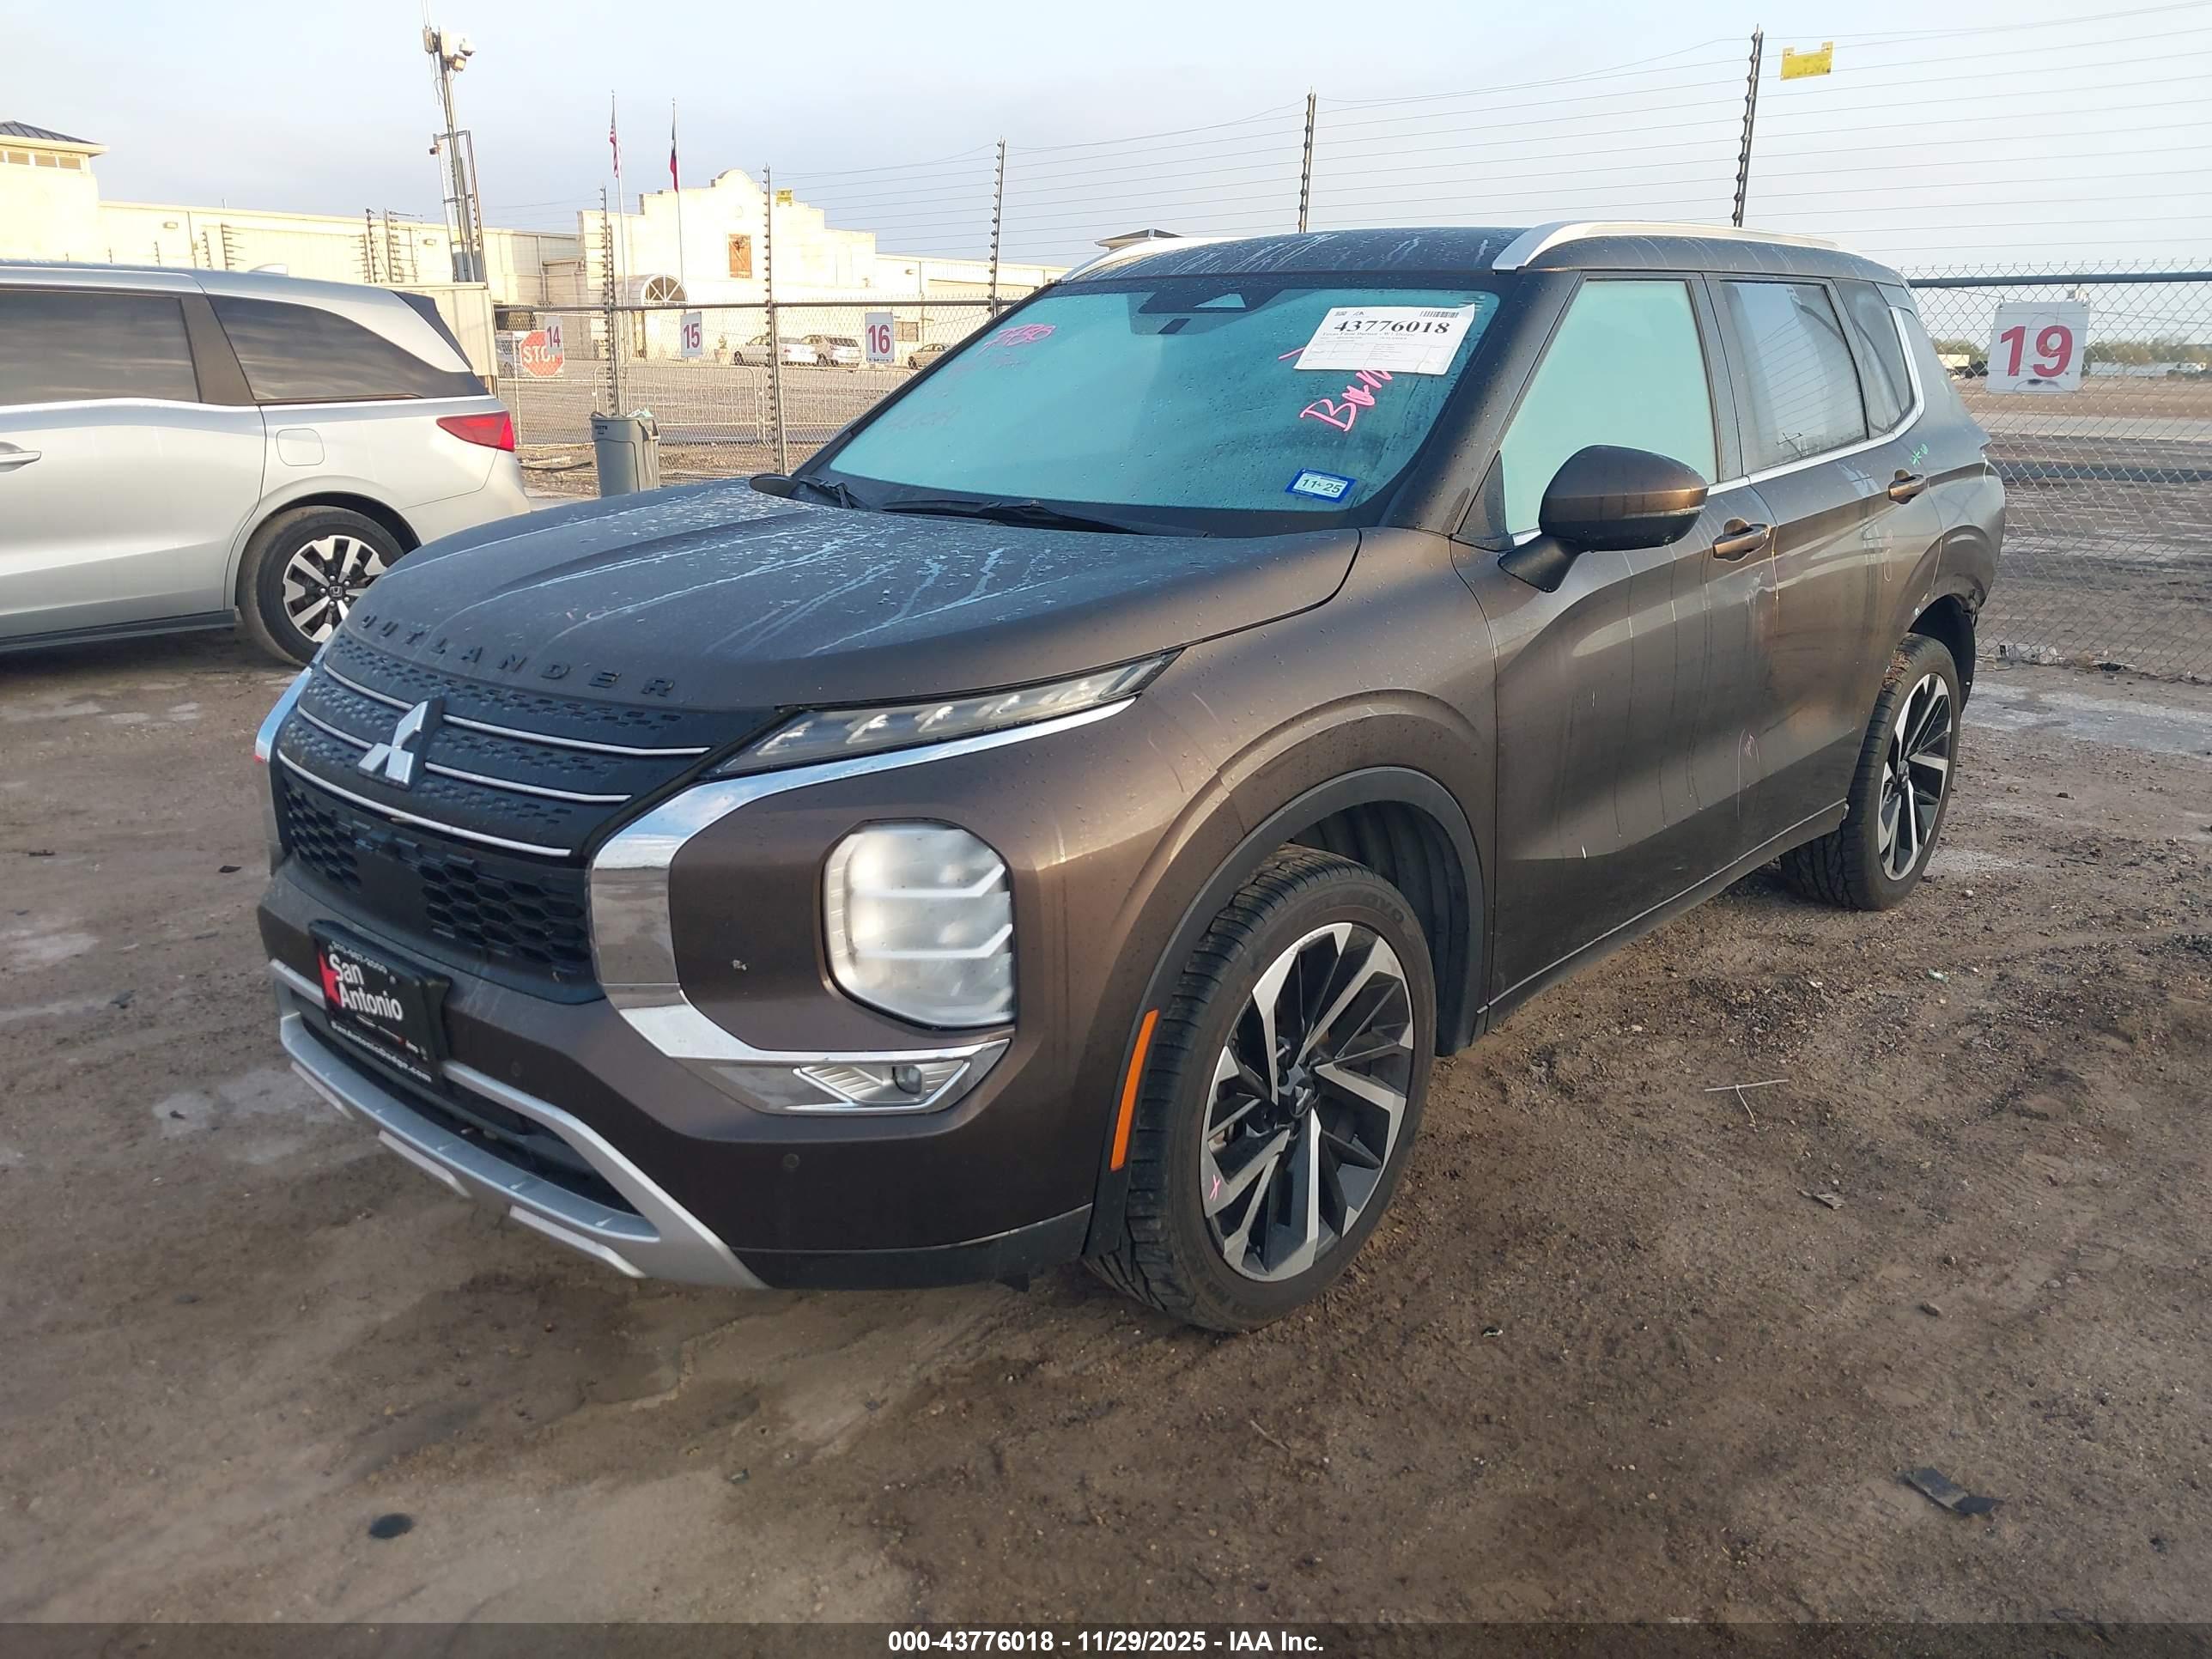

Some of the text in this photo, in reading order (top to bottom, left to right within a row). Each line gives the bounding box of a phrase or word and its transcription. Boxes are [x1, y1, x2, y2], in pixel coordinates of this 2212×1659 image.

[546, 325, 561, 349] 14
[683, 323, 701, 349] 15
[868, 324, 890, 354] 16
[1334, 319, 1450, 334] 43776018
[522, 344, 556, 363] STO
[2000, 325, 2074, 378] 19
[360, 612, 677, 698] OUTLANDER
[328, 953, 365, 985] San
[338, 981, 404, 1021] Antonio
